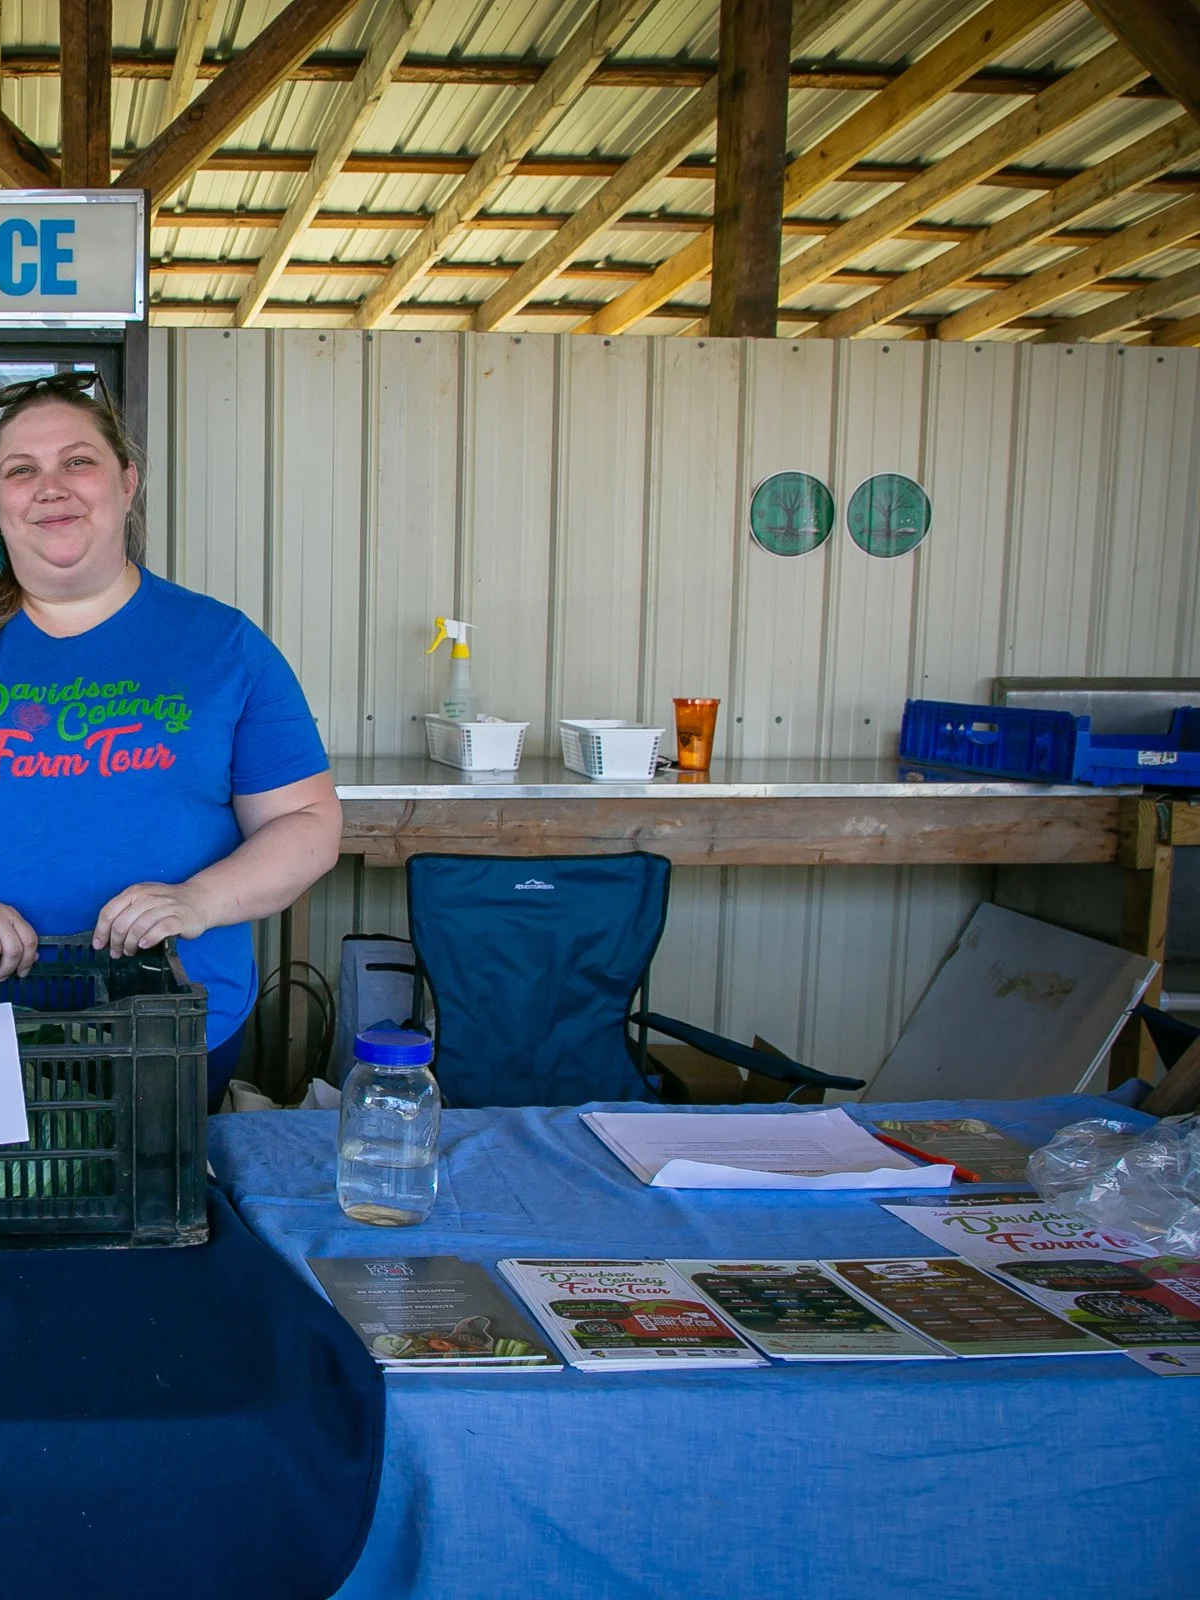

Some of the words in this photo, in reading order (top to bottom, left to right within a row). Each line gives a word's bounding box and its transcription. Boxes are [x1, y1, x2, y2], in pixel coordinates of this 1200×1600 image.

[57, 694, 192, 742] County
[84, 722, 177, 777] Tour
[985, 1231, 1102, 1253] Farm
[539, 1270, 635, 1284] Davidson
[597, 1276, 667, 1287] County
[558, 1282, 624, 1295] Farm
[617, 1283, 671, 1295] Tour
